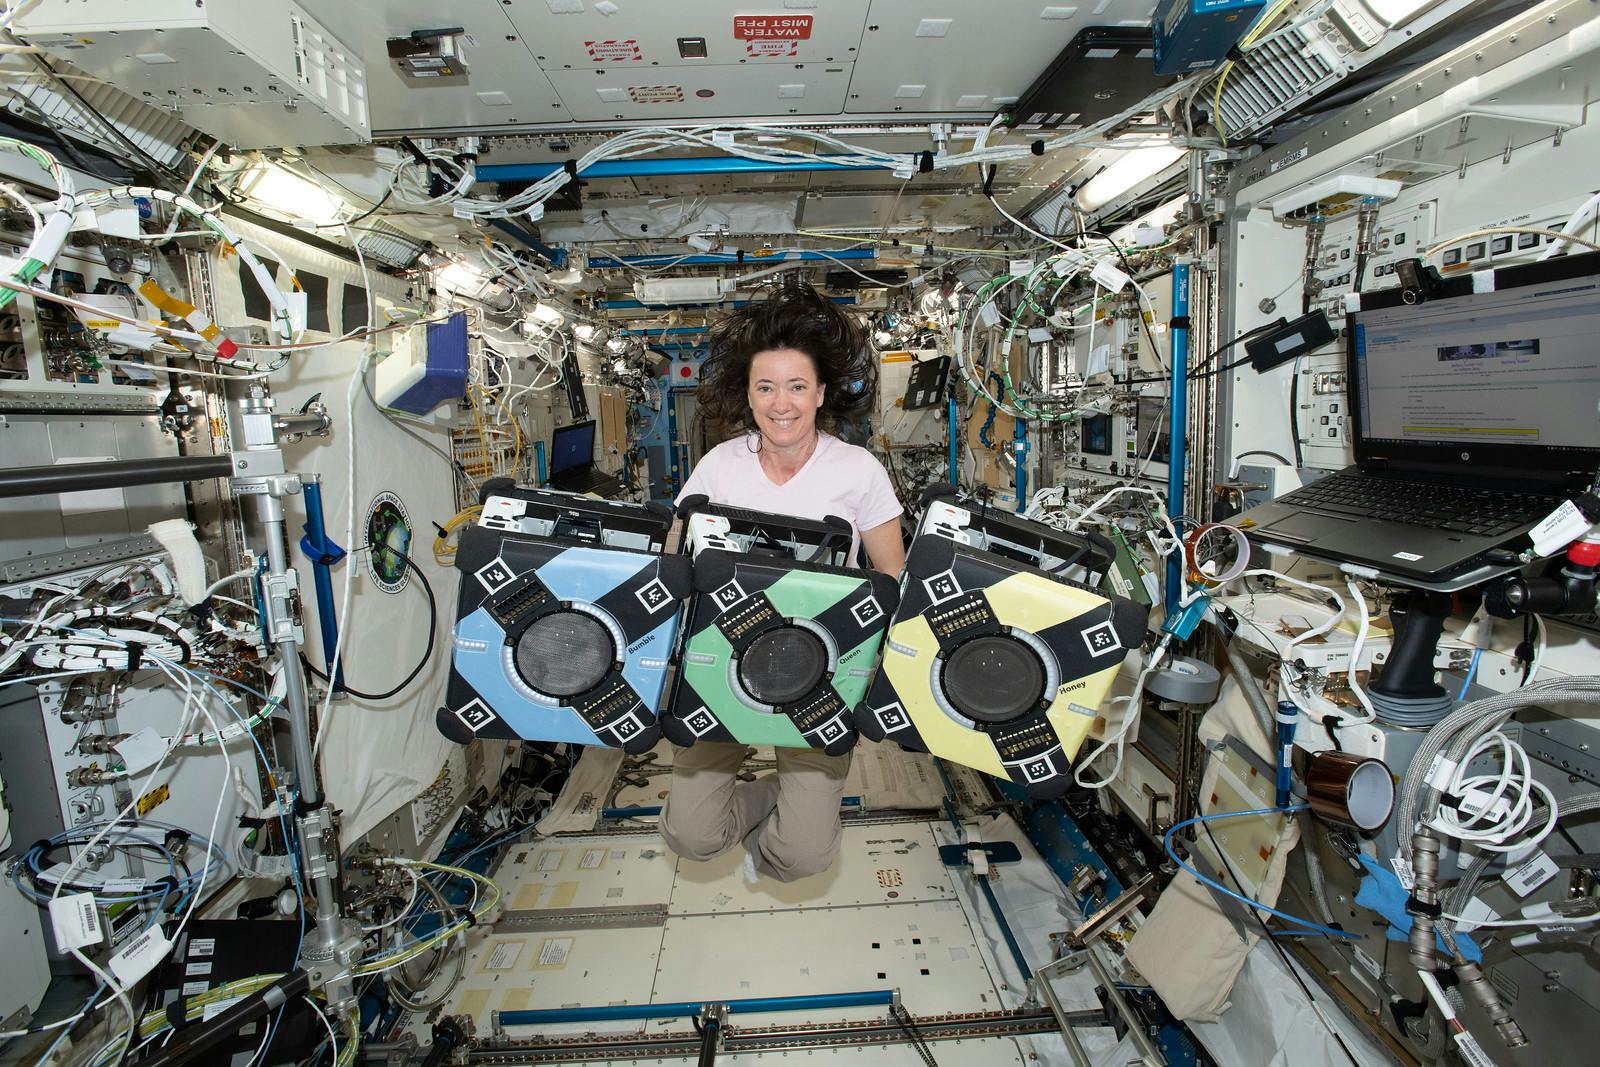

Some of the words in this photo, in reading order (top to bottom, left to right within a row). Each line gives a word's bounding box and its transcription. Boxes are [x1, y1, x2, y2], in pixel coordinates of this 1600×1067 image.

[735, 19, 767, 27] PFE
[771, 19, 809, 27] MIST
[1276, 151, 1303, 170] JEMRMS
[385, 494, 398, 505] SPACE
[379, 581, 402, 592] SCIENCES
[628, 634, 656, 655] Bumble
[839, 648, 862, 666] Queen
[1059, 682, 1086, 697] Honey
